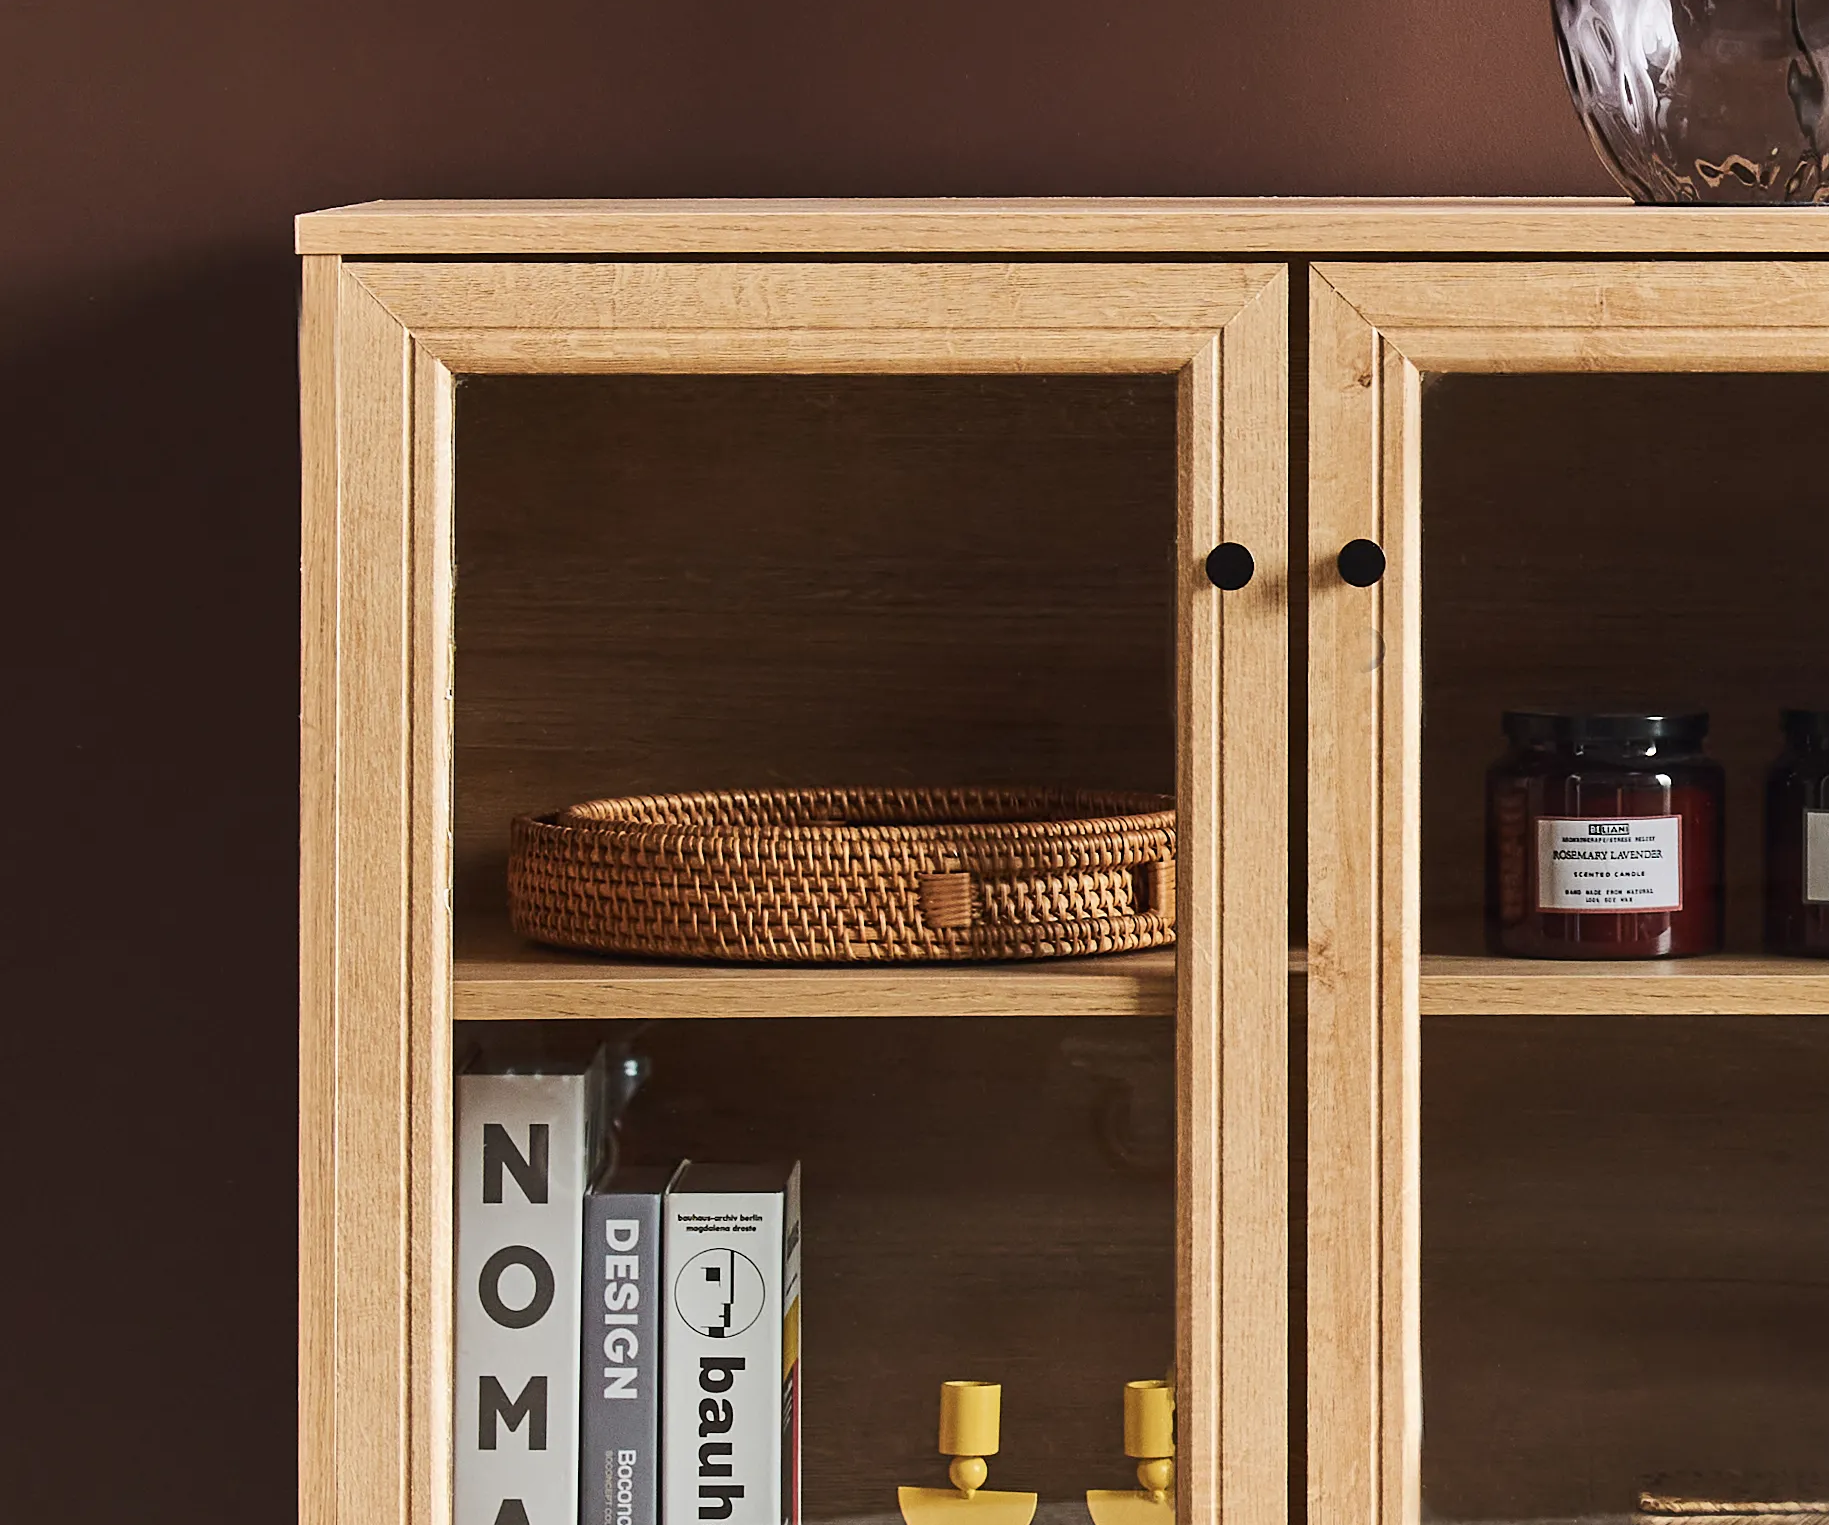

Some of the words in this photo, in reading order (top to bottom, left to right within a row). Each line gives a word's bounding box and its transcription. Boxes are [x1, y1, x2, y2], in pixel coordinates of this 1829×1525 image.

[1553, 850, 1608, 861] ROSEMARY
[1610, 849, 1663, 860] LAVENDER
[678, 1214, 738, 1222] bauhaus-archiv
[740, 1214, 763, 1222] berlin
[686, 1224, 730, 1234] magdalena
[732, 1224, 757, 1232] droste
[603, 1218, 640, 1400] DESIGN
